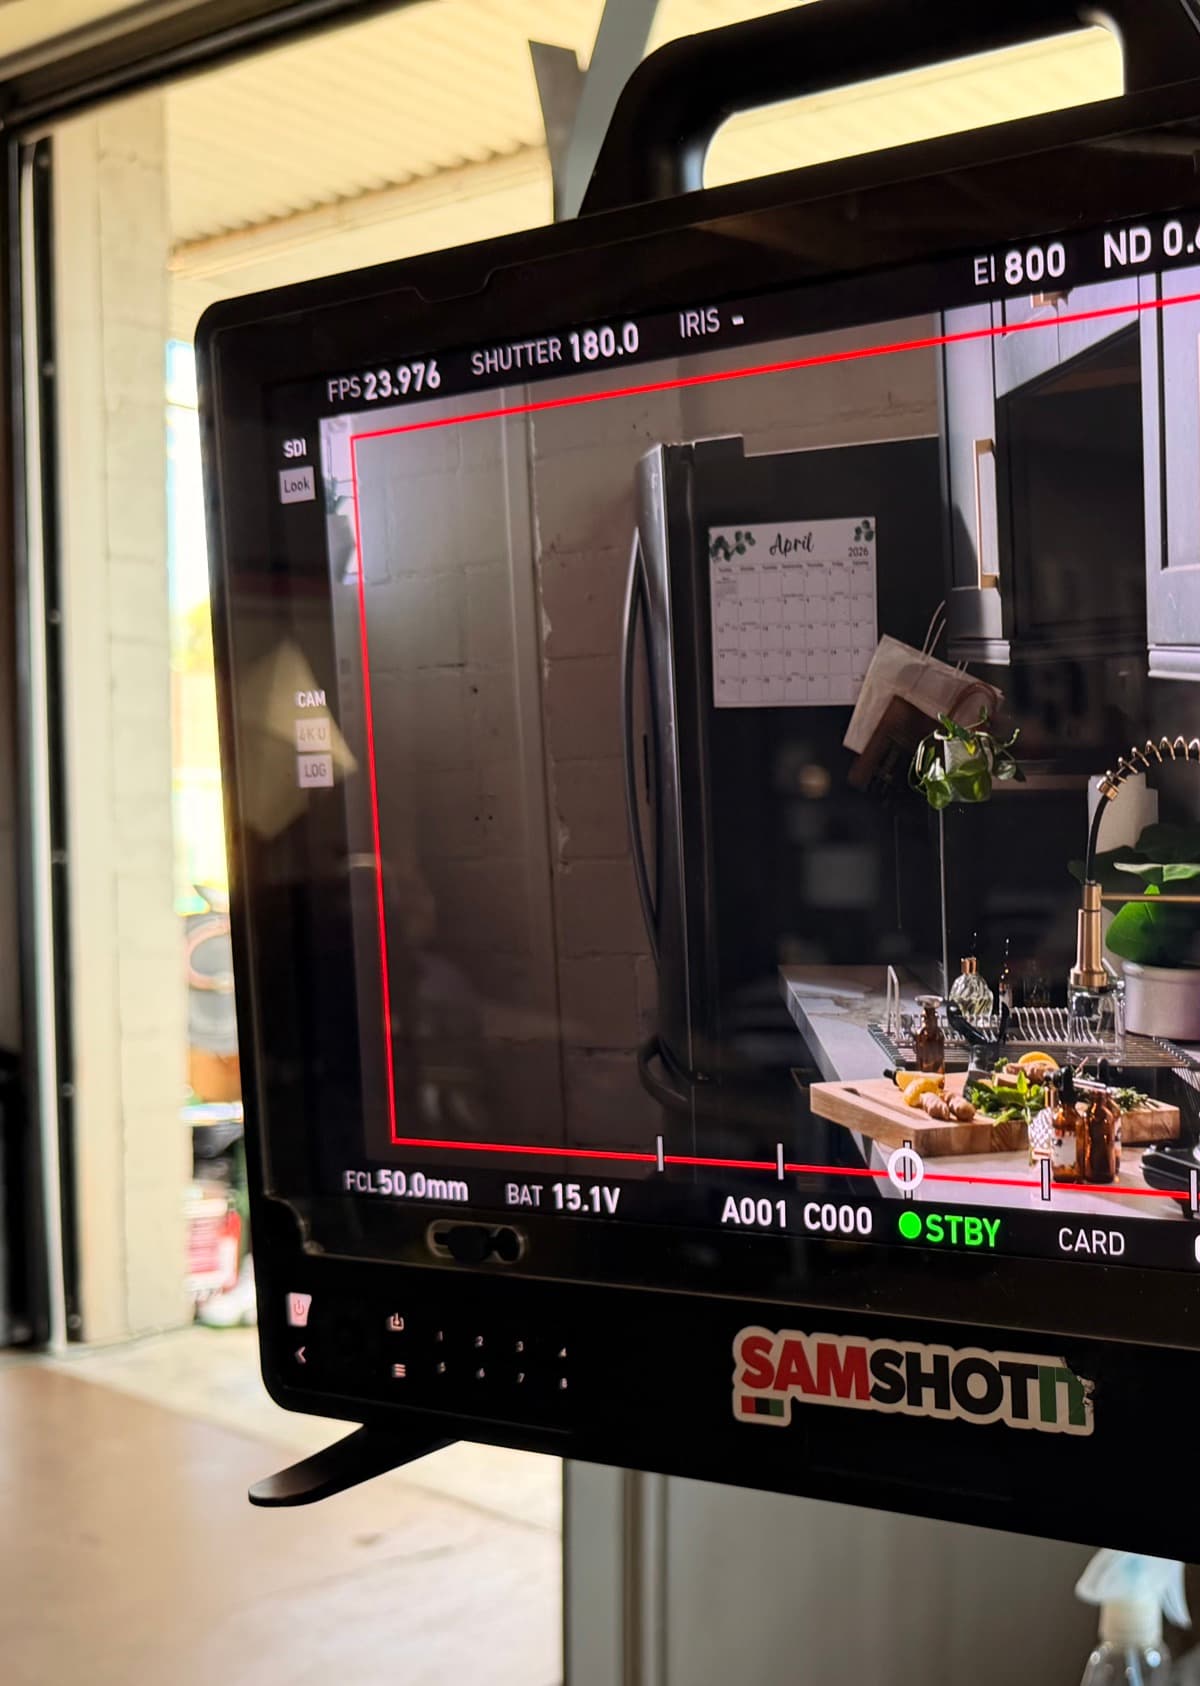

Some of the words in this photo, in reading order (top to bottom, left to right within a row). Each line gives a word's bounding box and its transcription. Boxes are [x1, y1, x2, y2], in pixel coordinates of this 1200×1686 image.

[973, 255, 996, 286] EI
[1004, 242, 1066, 285] 800
[1103, 226, 1152, 269] ND
[679, 307, 721, 339] IRIS
[471, 338, 563, 376] SHUTTER
[569, 322, 640, 363] 180.0
[327, 376, 362, 403] FPS
[363, 360, 441, 401] 23.976
[283, 438, 308, 458] SDI
[284, 475, 311, 495] Look
[769, 532, 814, 557] April
[297, 689, 327, 708] CAM
[304, 763, 327, 778] LOG
[344, 1169, 377, 1193] FCL
[377, 1168, 469, 1202] 50.0mm
[506, 1182, 544, 1207] BAT
[552, 1182, 621, 1215] 15.1V
[721, 1195, 787, 1228] A001
[803, 1202, 873, 1235] C000
[925, 1213, 1001, 1248] STBY
[1058, 1227, 1125, 1256] CARD
